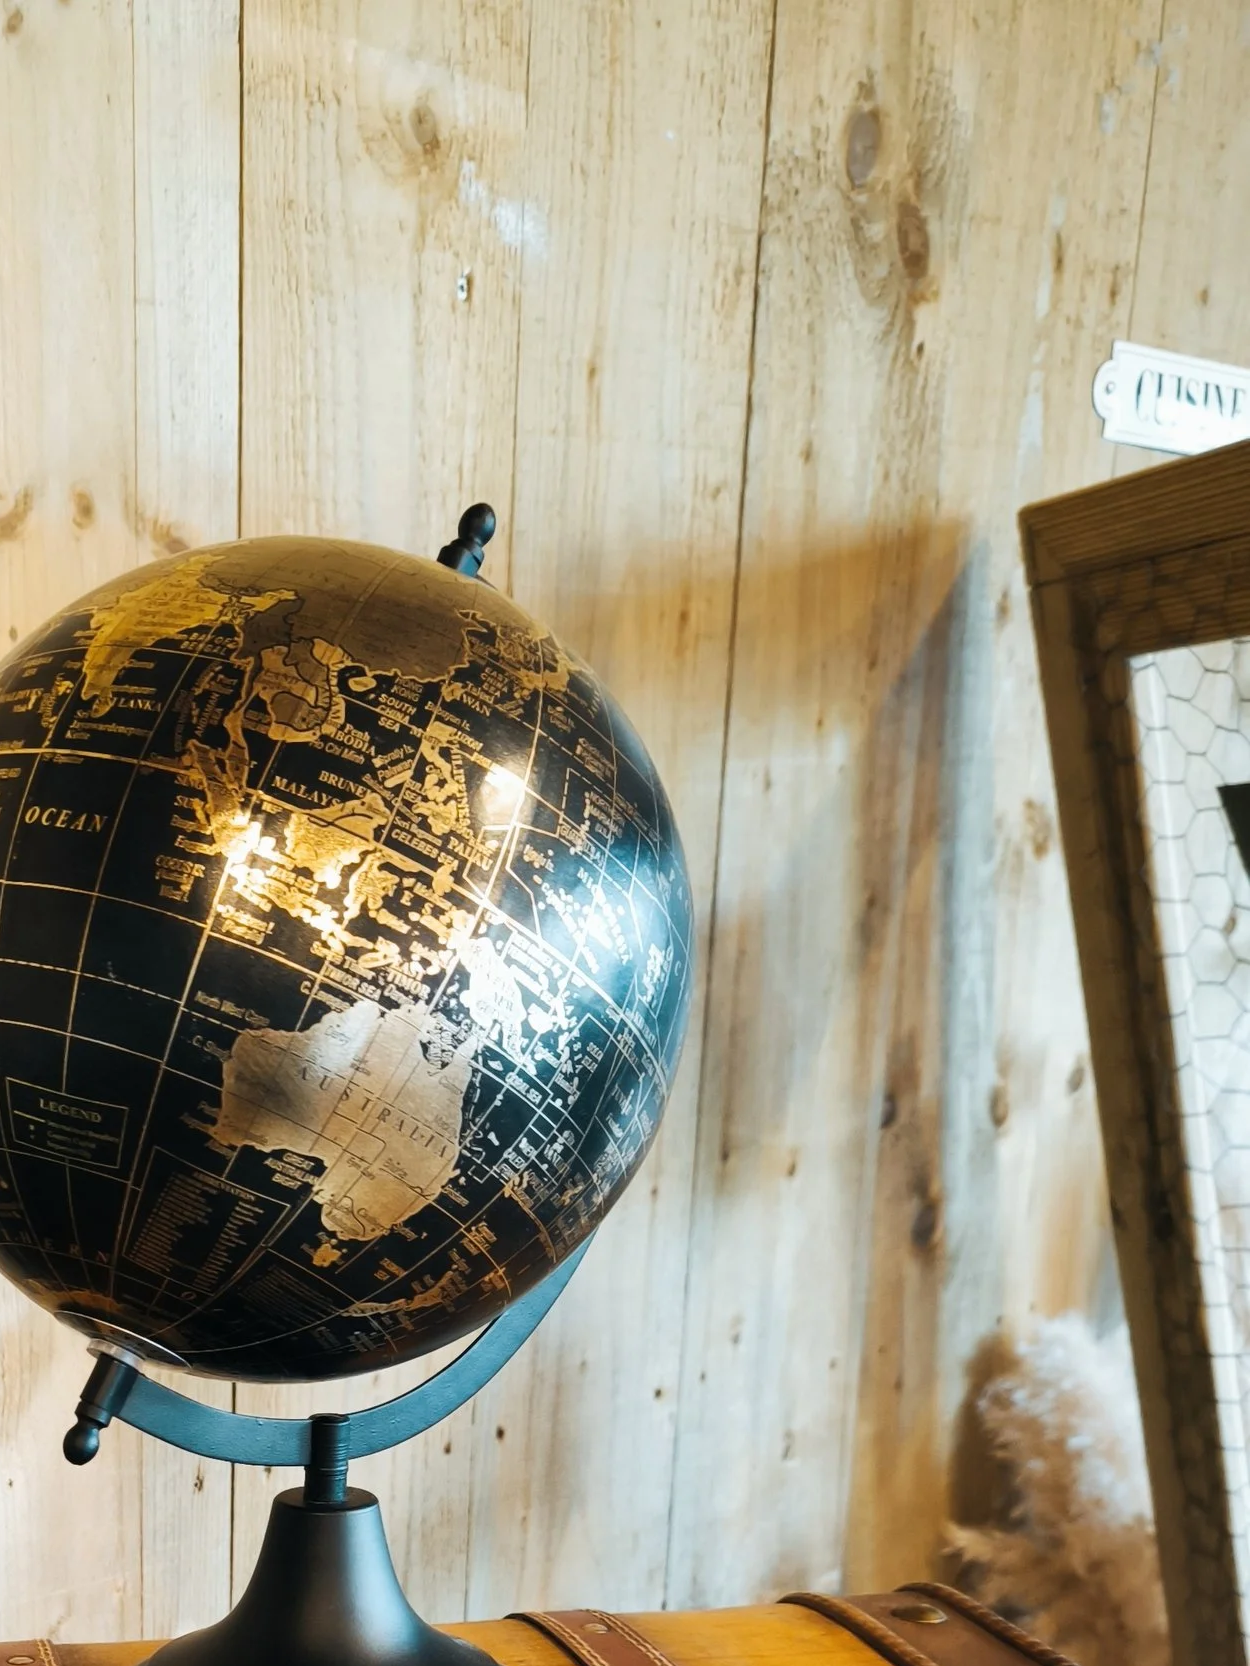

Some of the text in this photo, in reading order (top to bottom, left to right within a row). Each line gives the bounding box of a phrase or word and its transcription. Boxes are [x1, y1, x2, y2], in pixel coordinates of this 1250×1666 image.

[1135, 368, 1247, 427] CUISINE
[377, 704, 412, 725] CHINA
[378, 693, 417, 716] SOUTH
[377, 715, 401, 733] SEA
[24, 805, 109, 834] OCEAN
[391, 829, 460, 872] CELEBES SEA
[39, 1098, 102, 1123] LEGEND
[300, 1065, 448, 1159] AUSTRALIA
